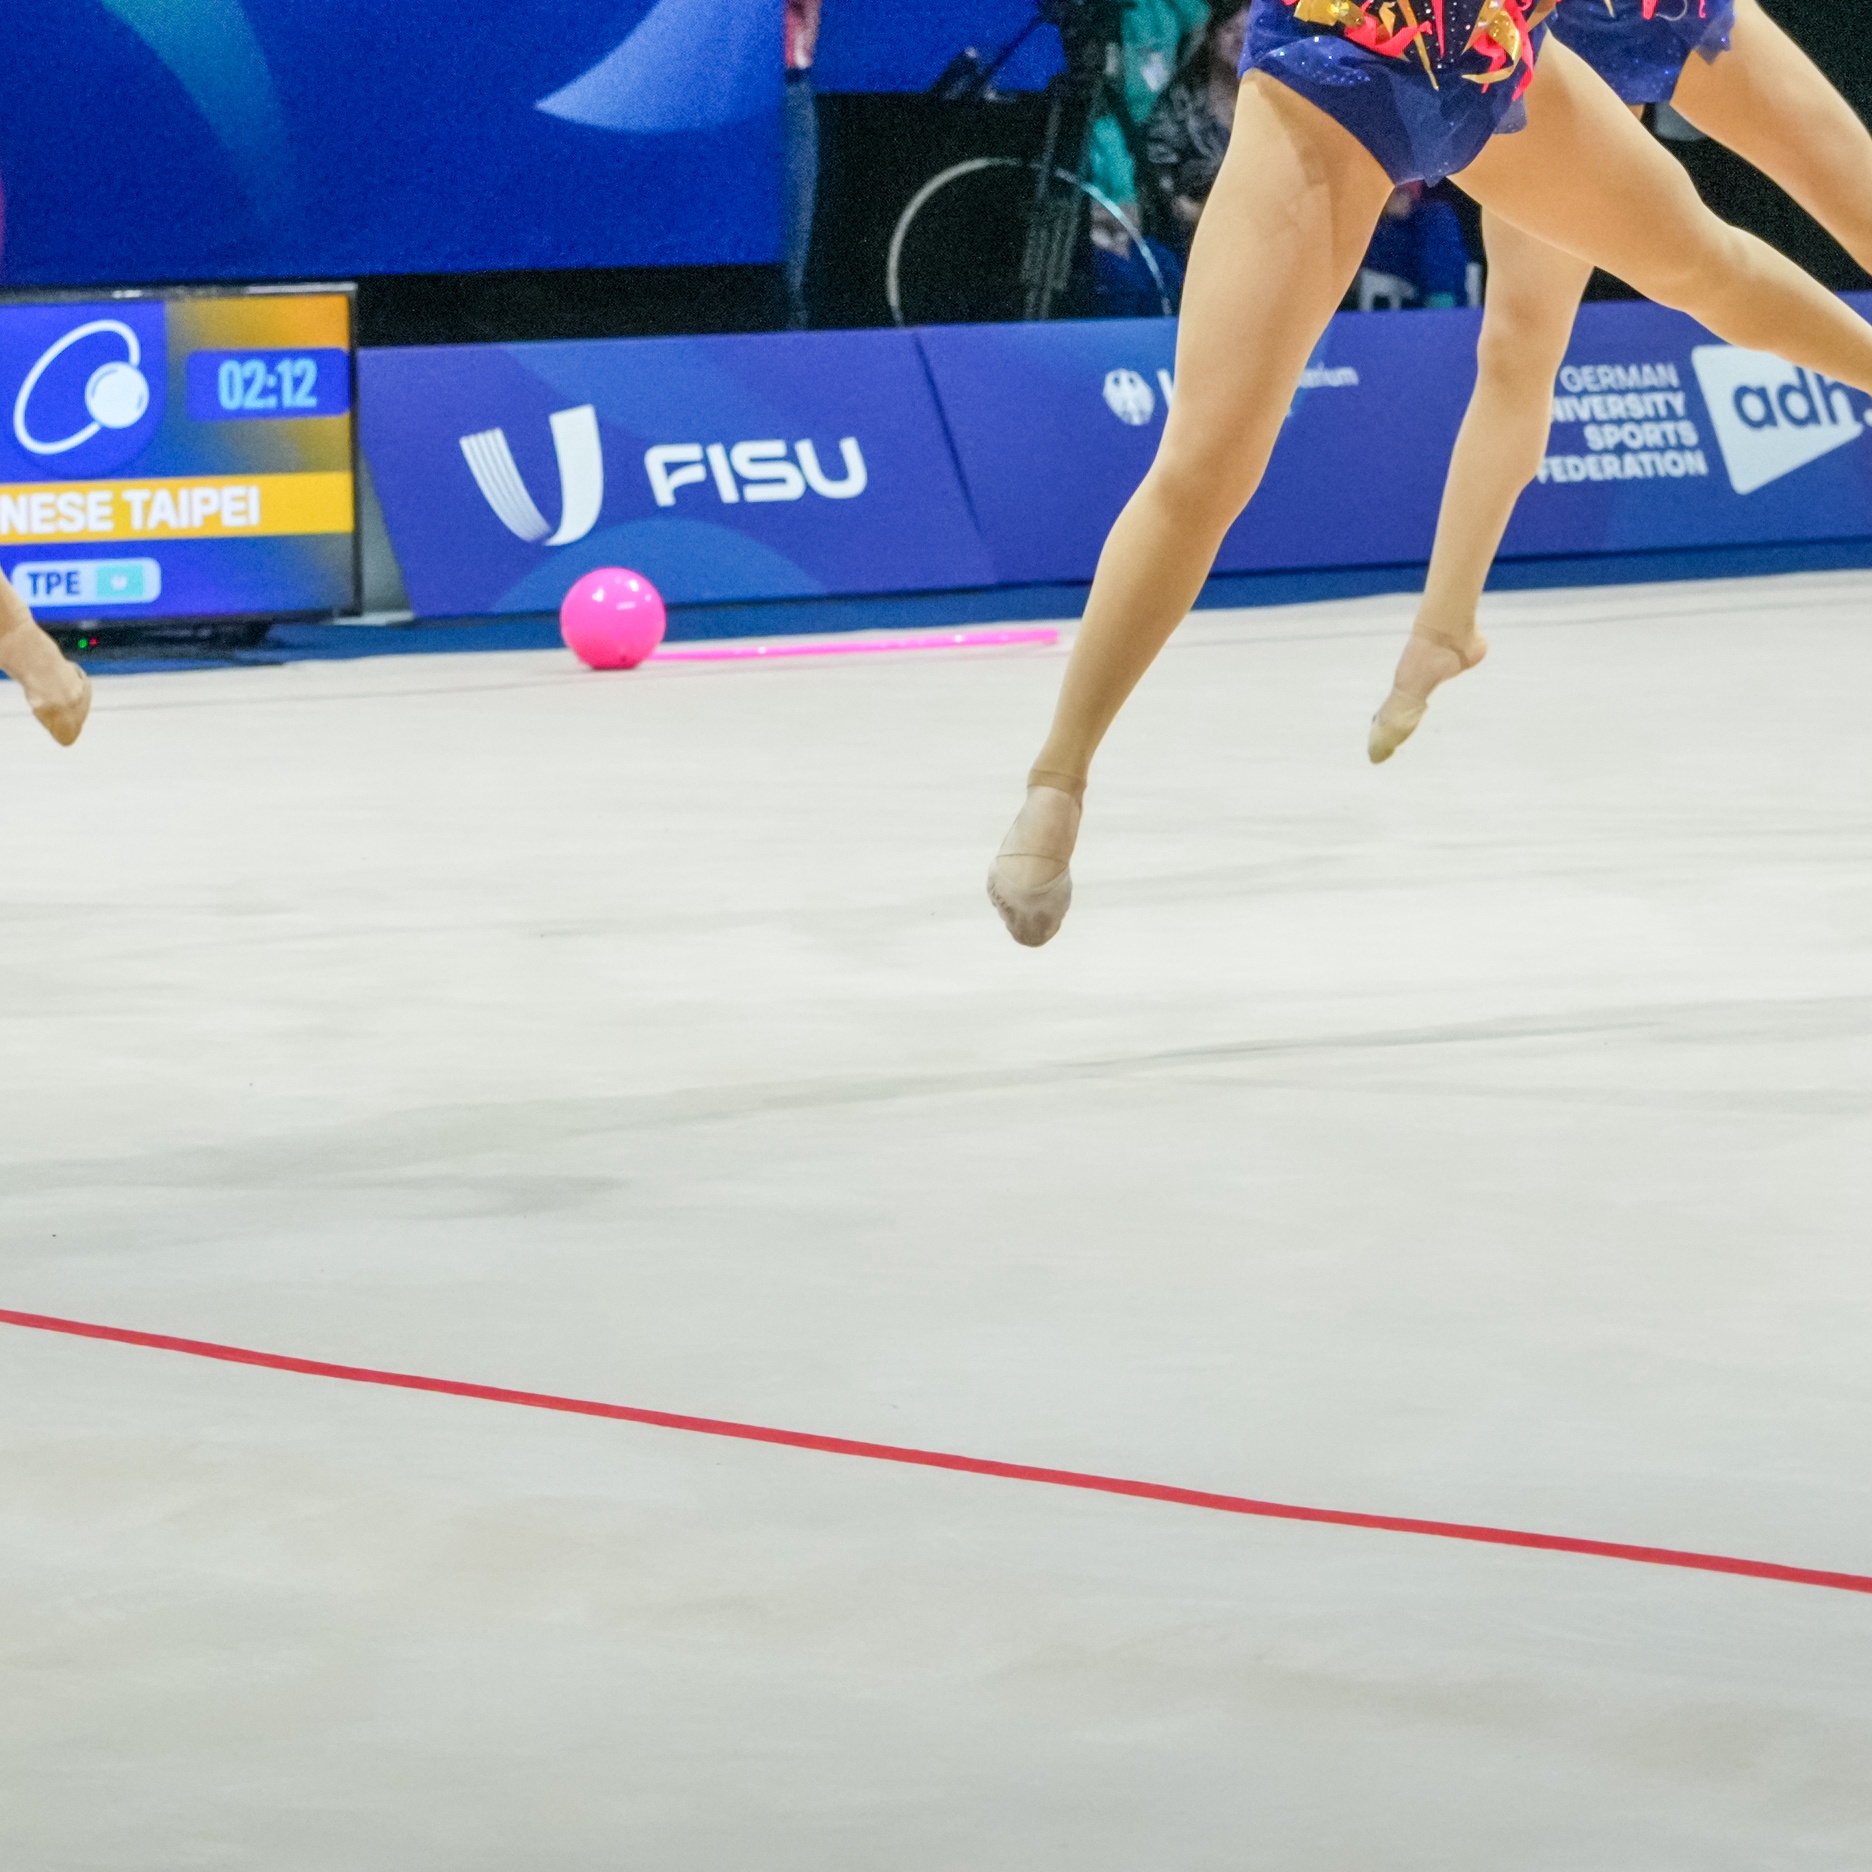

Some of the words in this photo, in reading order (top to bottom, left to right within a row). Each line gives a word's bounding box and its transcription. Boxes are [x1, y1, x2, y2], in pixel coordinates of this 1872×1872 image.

[217, 357, 318, 410] 02:12
[1559, 361, 1680, 393] GERMAN
[1583, 419, 1700, 453] SPORTS
[644, 436, 868, 507] FISU
[121, 485, 261, 530] TAIPEI
[27, 570, 81, 597] TPE
